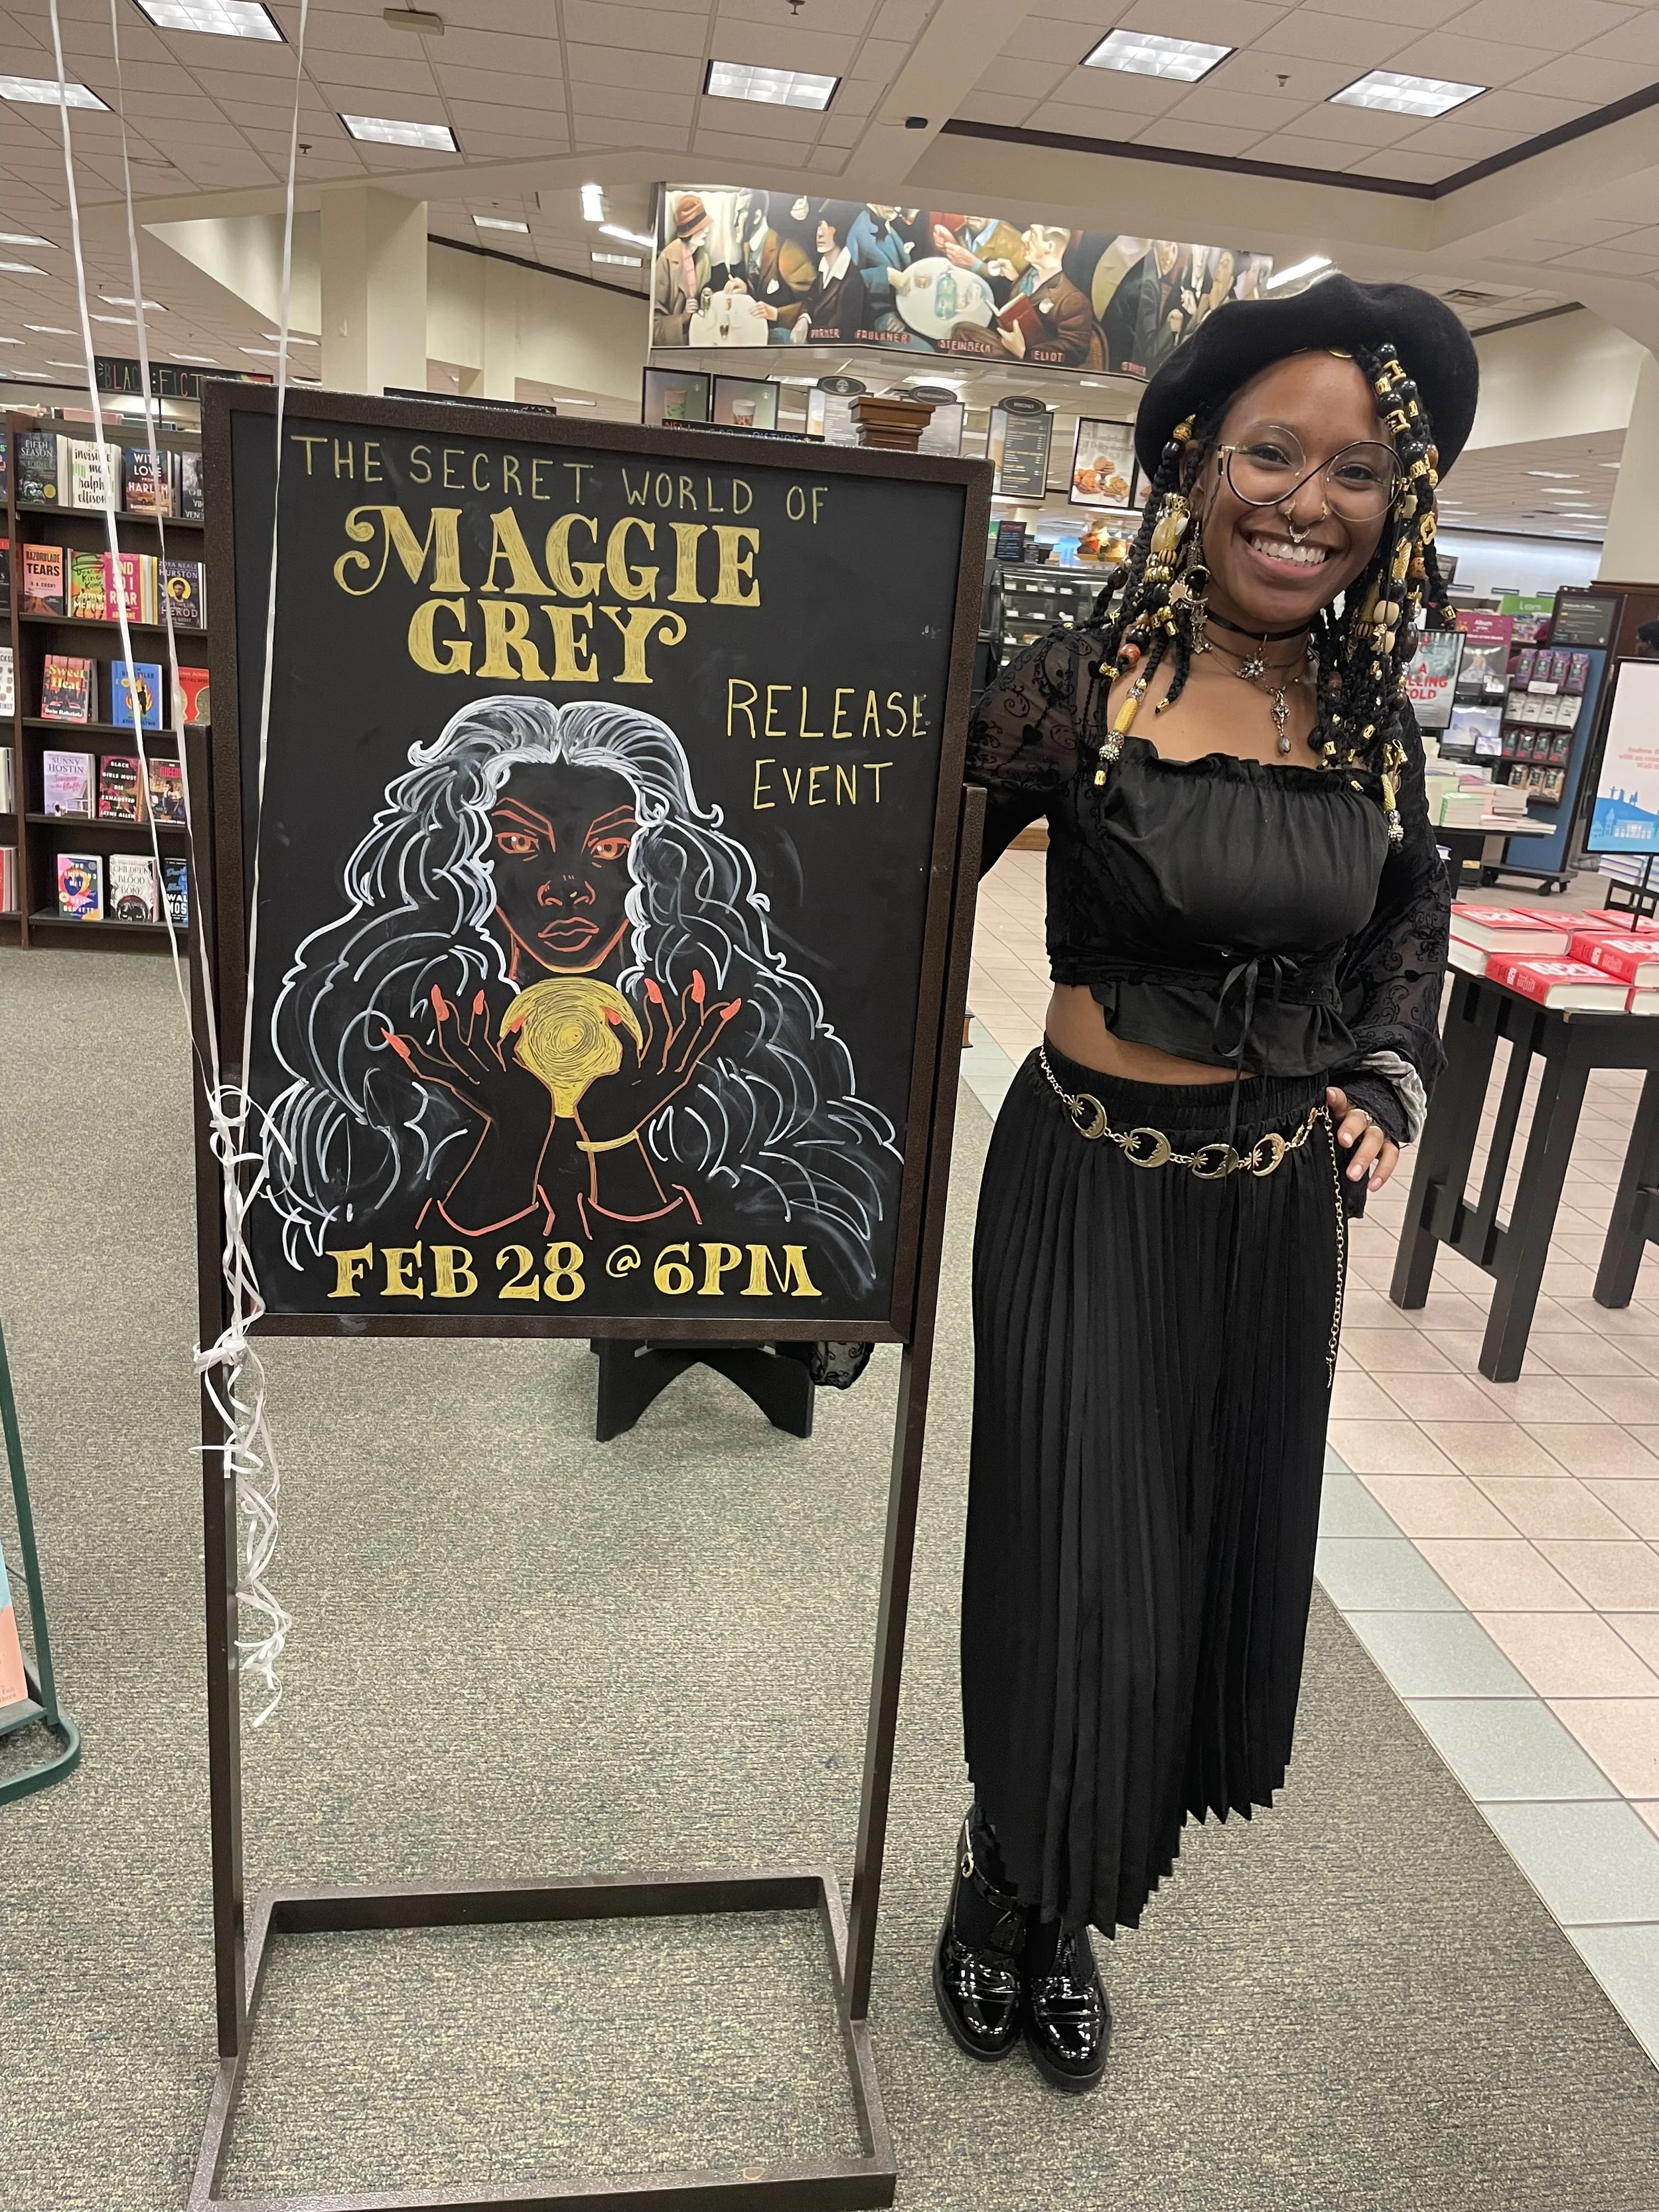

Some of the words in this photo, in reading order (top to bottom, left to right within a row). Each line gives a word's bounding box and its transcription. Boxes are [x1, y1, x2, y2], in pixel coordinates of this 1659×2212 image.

[855, 329, 910, 344] FAULKNER
[939, 339, 991, 353] STEINBECK
[1033, 350, 1064, 362] ELIOT
[104, 363, 142, 392] BLAC
[159, 369, 204, 398] FICT
[25, 440, 48, 449] FIFTH
[21, 448, 52, 457] SEASON
[74, 448, 111, 463] invisie
[134, 453, 160, 465] WITH
[89, 464, 111, 475] ma
[134, 465, 161, 477] LOVE
[79, 475, 105, 492] ralph
[289, 435, 383, 482] THE
[409, 445, 595, 504] SECRET
[621, 467, 753, 515] WORLD
[786, 485, 829, 524] OF
[129, 482, 168, 495] HARLM
[78, 490, 106, 504] ellison
[333, 505, 760, 608] MAGGIE
[27, 563, 60, 576] TEARS
[159, 569, 198, 579] HURSTON
[109, 591, 137, 605] RAR
[73, 601, 105, 611] McBrid
[407, 597, 687, 684] GREY
[49, 664, 85, 678] Sweet
[1418, 663, 1427, 674] A
[50, 677, 81, 690] Heat
[1406, 675, 1449, 688] ILLING
[727, 678, 928, 739] RELEASE
[52, 757, 80, 766] SUNNY
[48, 764, 84, 773] HOSTIN
[753, 759, 893, 810] EVENT
[113, 864, 149, 874] CHILDREN
[118, 875, 145, 884] BLOOD
[121, 885, 142, 895] BONE
[167, 893, 188, 902] WAL
[325, 1240, 480, 1301] FEB
[496, 1241, 586, 1302] 28
[605, 1244, 642, 1278] @
[653, 1241, 823, 1298] 6PM
